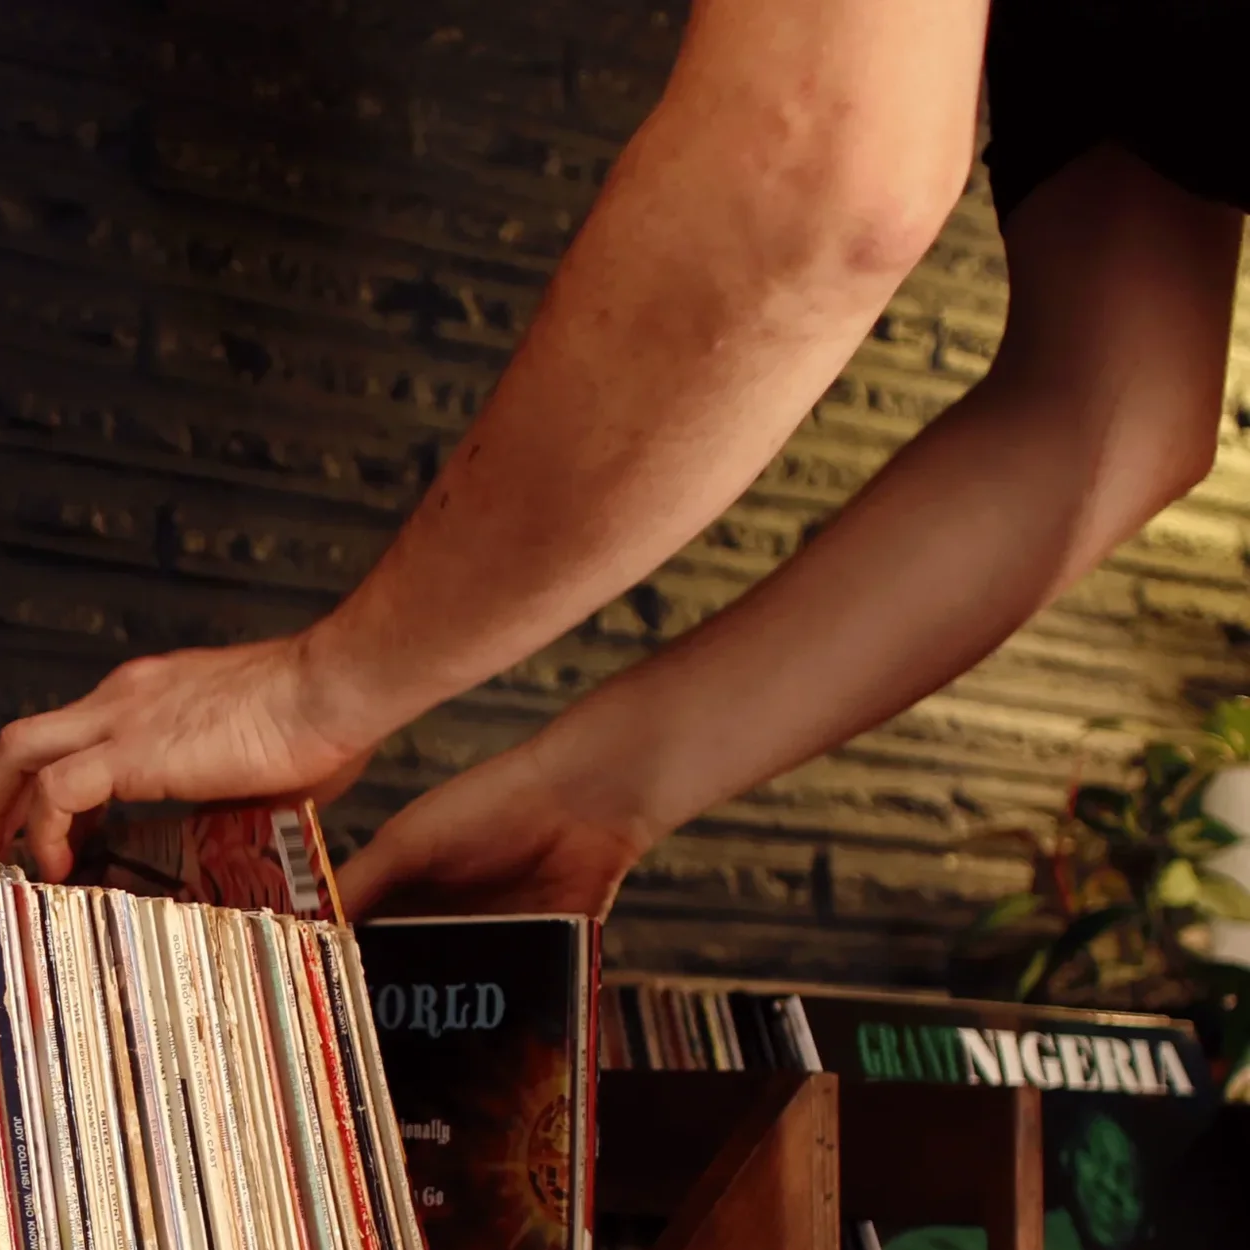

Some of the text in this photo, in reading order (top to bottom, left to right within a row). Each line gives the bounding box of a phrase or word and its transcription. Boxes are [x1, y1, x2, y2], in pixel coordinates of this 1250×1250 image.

[369, 982, 506, 1038] ORLD
[172, 934, 218, 1170] GOLDEN BOY ORIGINAL BROADWAY CAST
[956, 1026, 1195, 1097] NIGERIA
[12, 1116, 24, 1141] JUDY
[150, 1118, 162, 1167] ELEVATOR
[17, 1143, 30, 1190] COLLINS/
[100, 1110, 109, 1145] GRIEG
[106, 1156, 115, 1186] PEER
[111, 1193, 120, 1223] GYNT
[316, 1142, 329, 1177] MERCURY
[22, 1194, 35, 1218] WHO
[422, 1185, 444, 1206] Go
